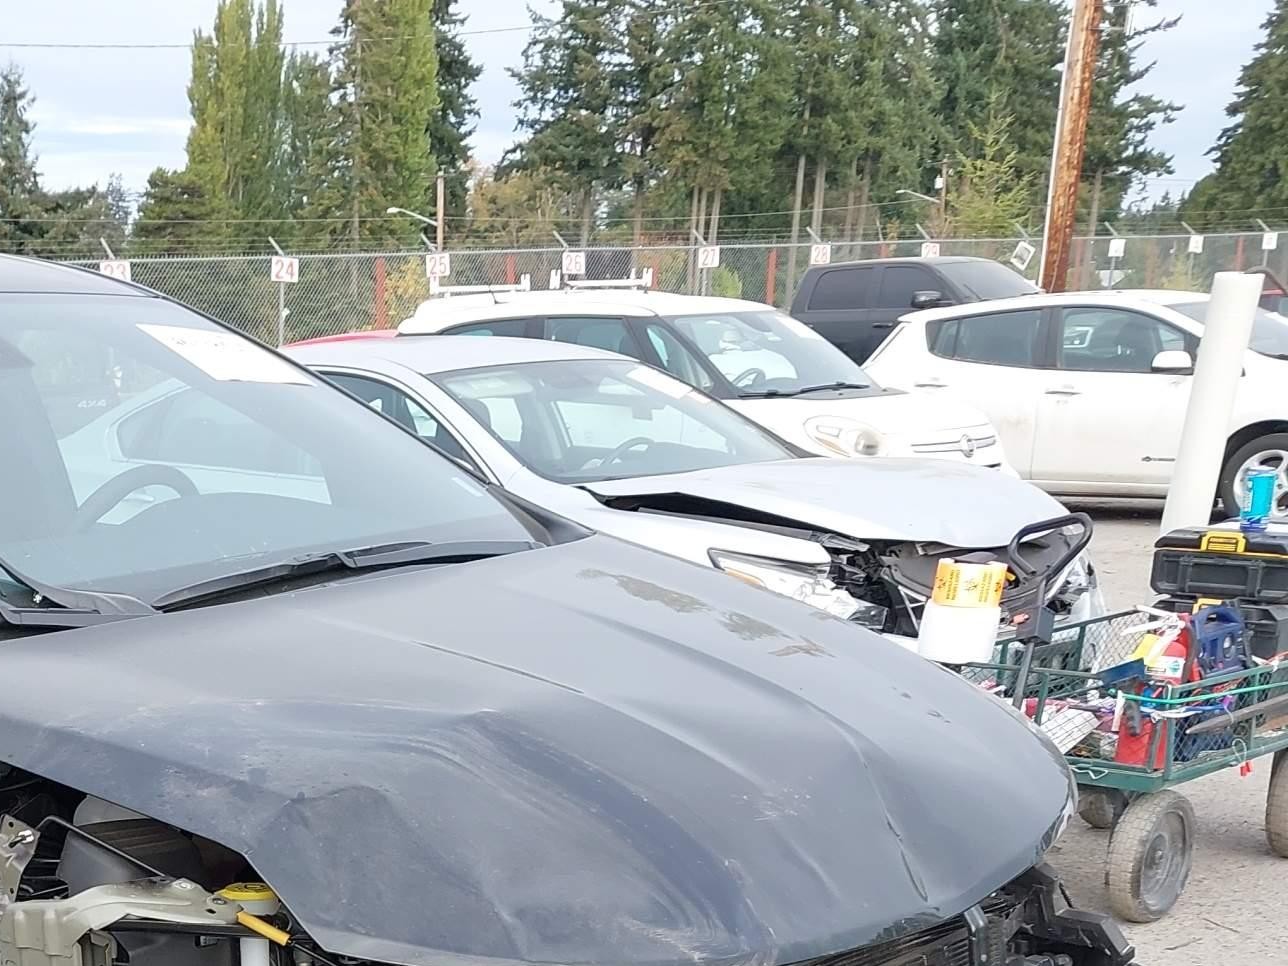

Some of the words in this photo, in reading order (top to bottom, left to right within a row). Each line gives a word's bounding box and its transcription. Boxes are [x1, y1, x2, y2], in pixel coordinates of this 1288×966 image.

[566, 254, 582, 271] 26
[702, 248, 715, 266] 27
[814, 246, 828, 263] 28
[275, 259, 294, 280] 24
[429, 256, 446, 275] 25
